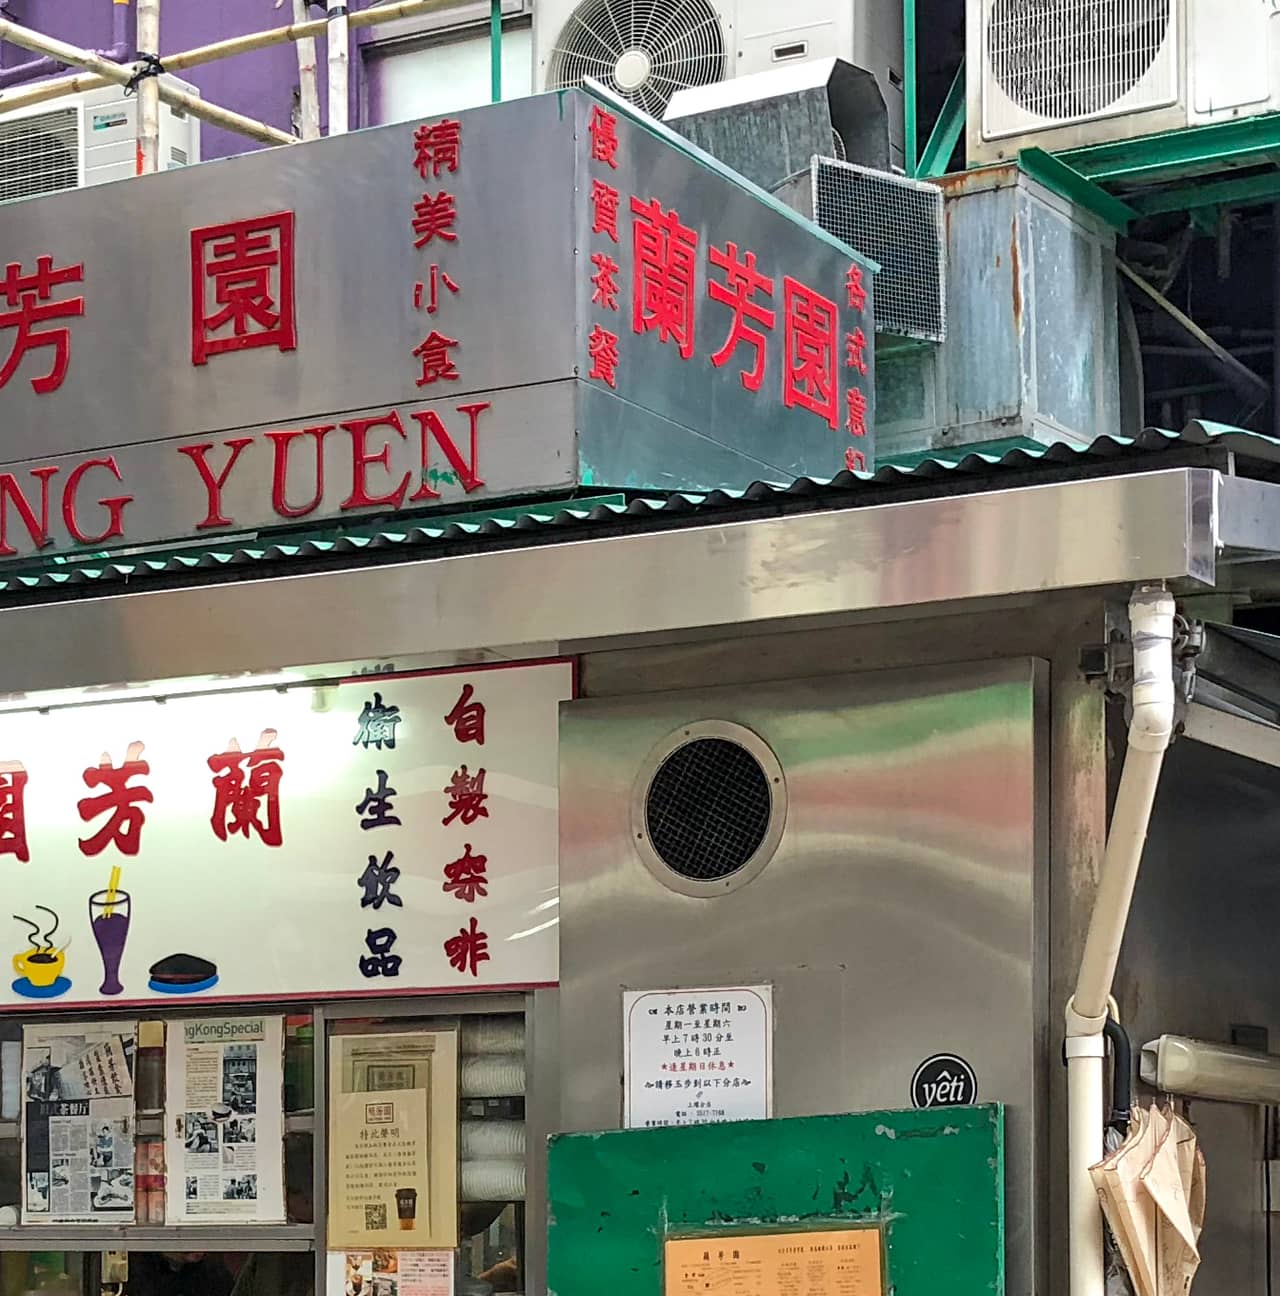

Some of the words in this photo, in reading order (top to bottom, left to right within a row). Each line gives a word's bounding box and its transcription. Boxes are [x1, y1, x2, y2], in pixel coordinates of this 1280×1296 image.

[411, 117, 463, 388] 精美小食
[630, 194, 839, 431] 蘭芳園
[177, 401, 492, 530] YUEN
[922, 1071, 965, 1105] yêti
